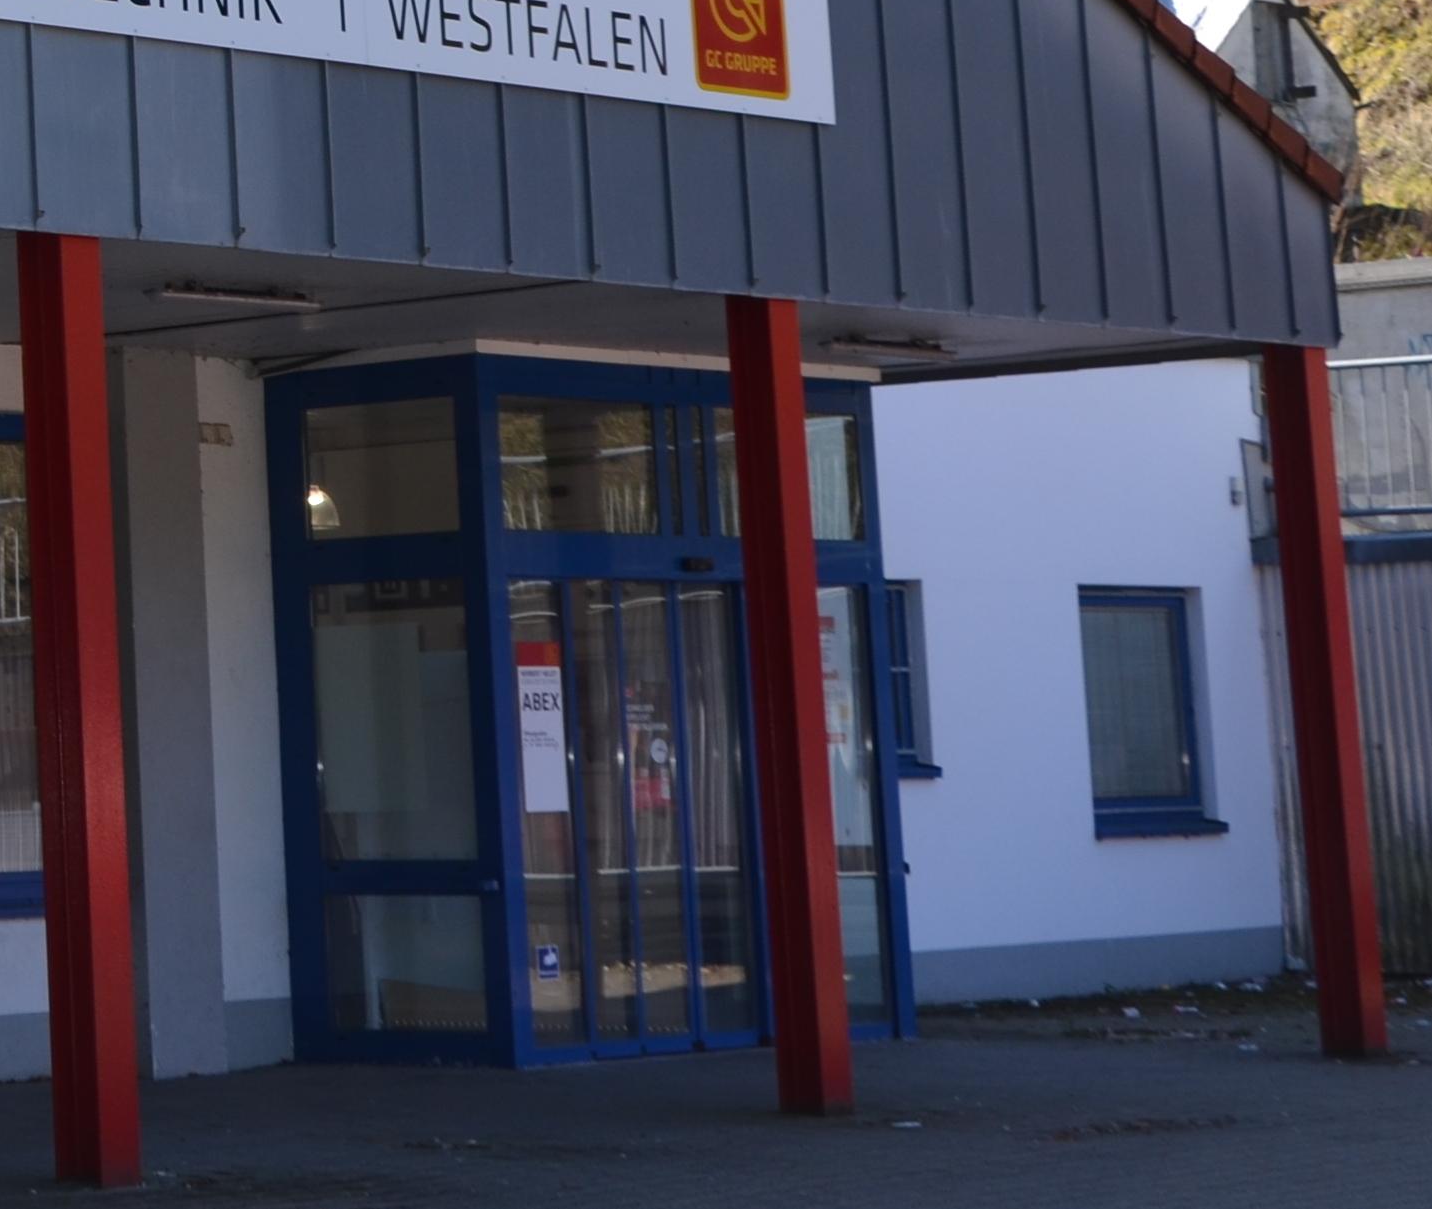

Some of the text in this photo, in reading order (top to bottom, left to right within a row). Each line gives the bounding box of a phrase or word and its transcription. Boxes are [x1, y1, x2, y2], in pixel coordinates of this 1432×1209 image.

[706, 49, 778, 76] GC GRUPPE
[523, 692, 560, 711] ABEX
